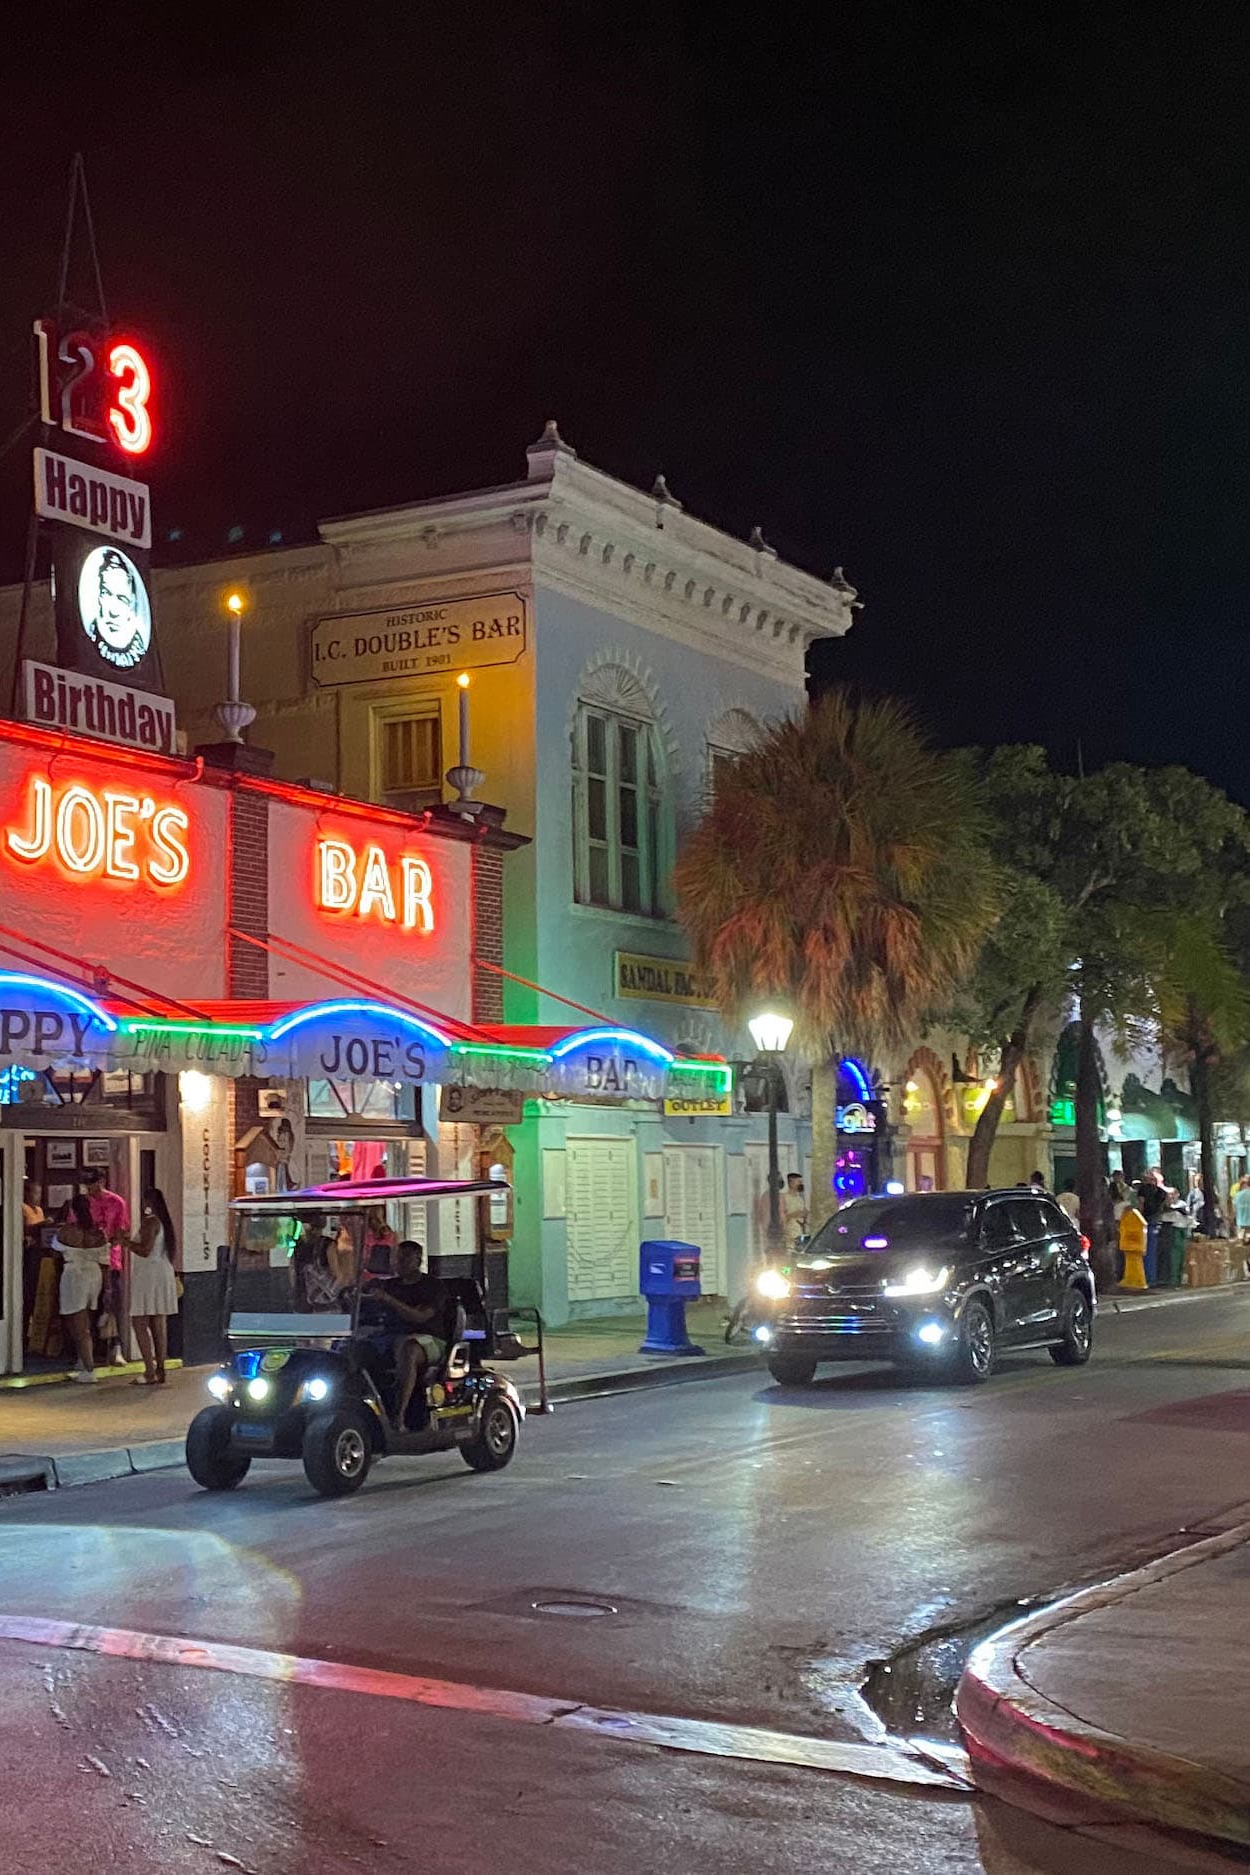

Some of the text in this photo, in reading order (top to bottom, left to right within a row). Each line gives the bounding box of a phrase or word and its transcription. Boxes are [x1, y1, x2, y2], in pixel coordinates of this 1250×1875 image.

[45, 456, 145, 540] Happy
[354, 624, 461, 657] DOUBLE'S
[471, 616, 521, 642] BAR
[386, 609, 449, 628] HISTORIC
[382, 653, 452, 673] BUILT 1901
[33, 668, 173, 752] Birthday
[5, 779, 190, 886] JOE'S
[317, 839, 436, 931] BAR
[320, 1035, 425, 1079] JOE'S
[201, 1127, 211, 1261] COCKTAILS
